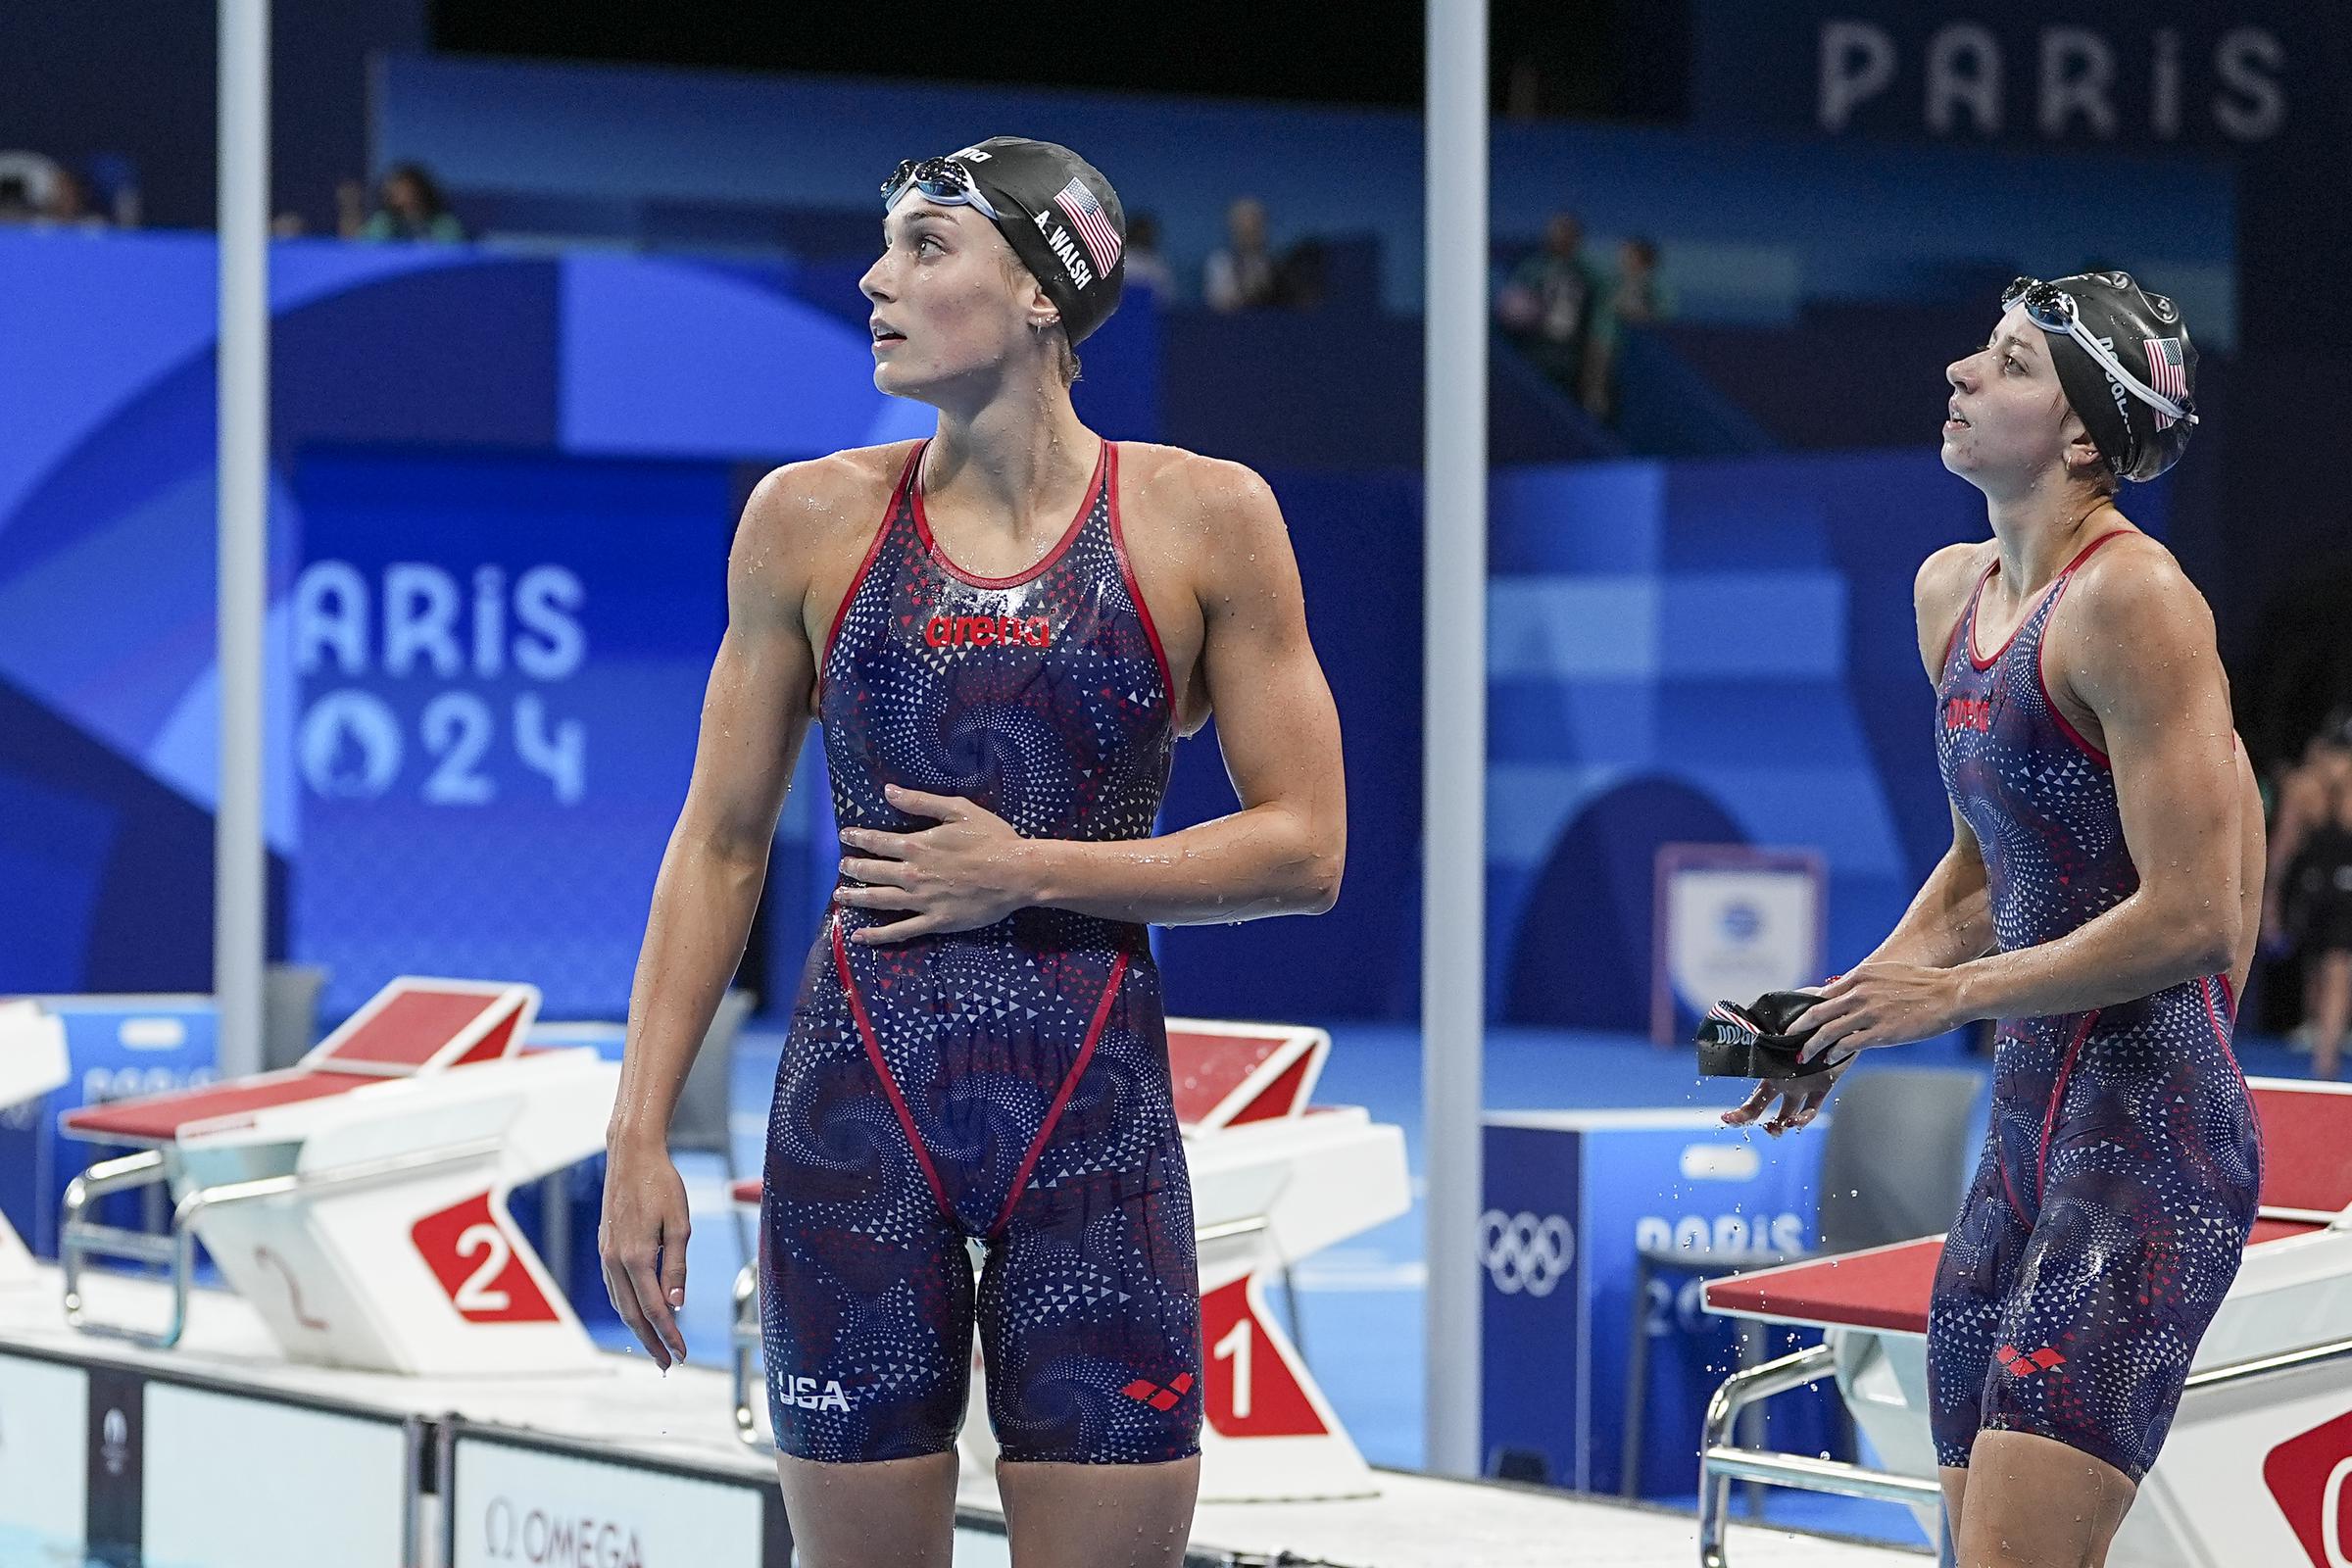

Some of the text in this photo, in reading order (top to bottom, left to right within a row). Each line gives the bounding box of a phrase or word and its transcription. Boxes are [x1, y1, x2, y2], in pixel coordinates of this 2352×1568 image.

[1048, 224, 1093, 290] WALSH
[925, 614, 1051, 648] arena
[455, 1223, 512, 1311] 2
[777, 1372, 852, 1412] USA
[1213, 1317, 1252, 1419] 1
[522, 1507, 645, 1568] OMEGA
